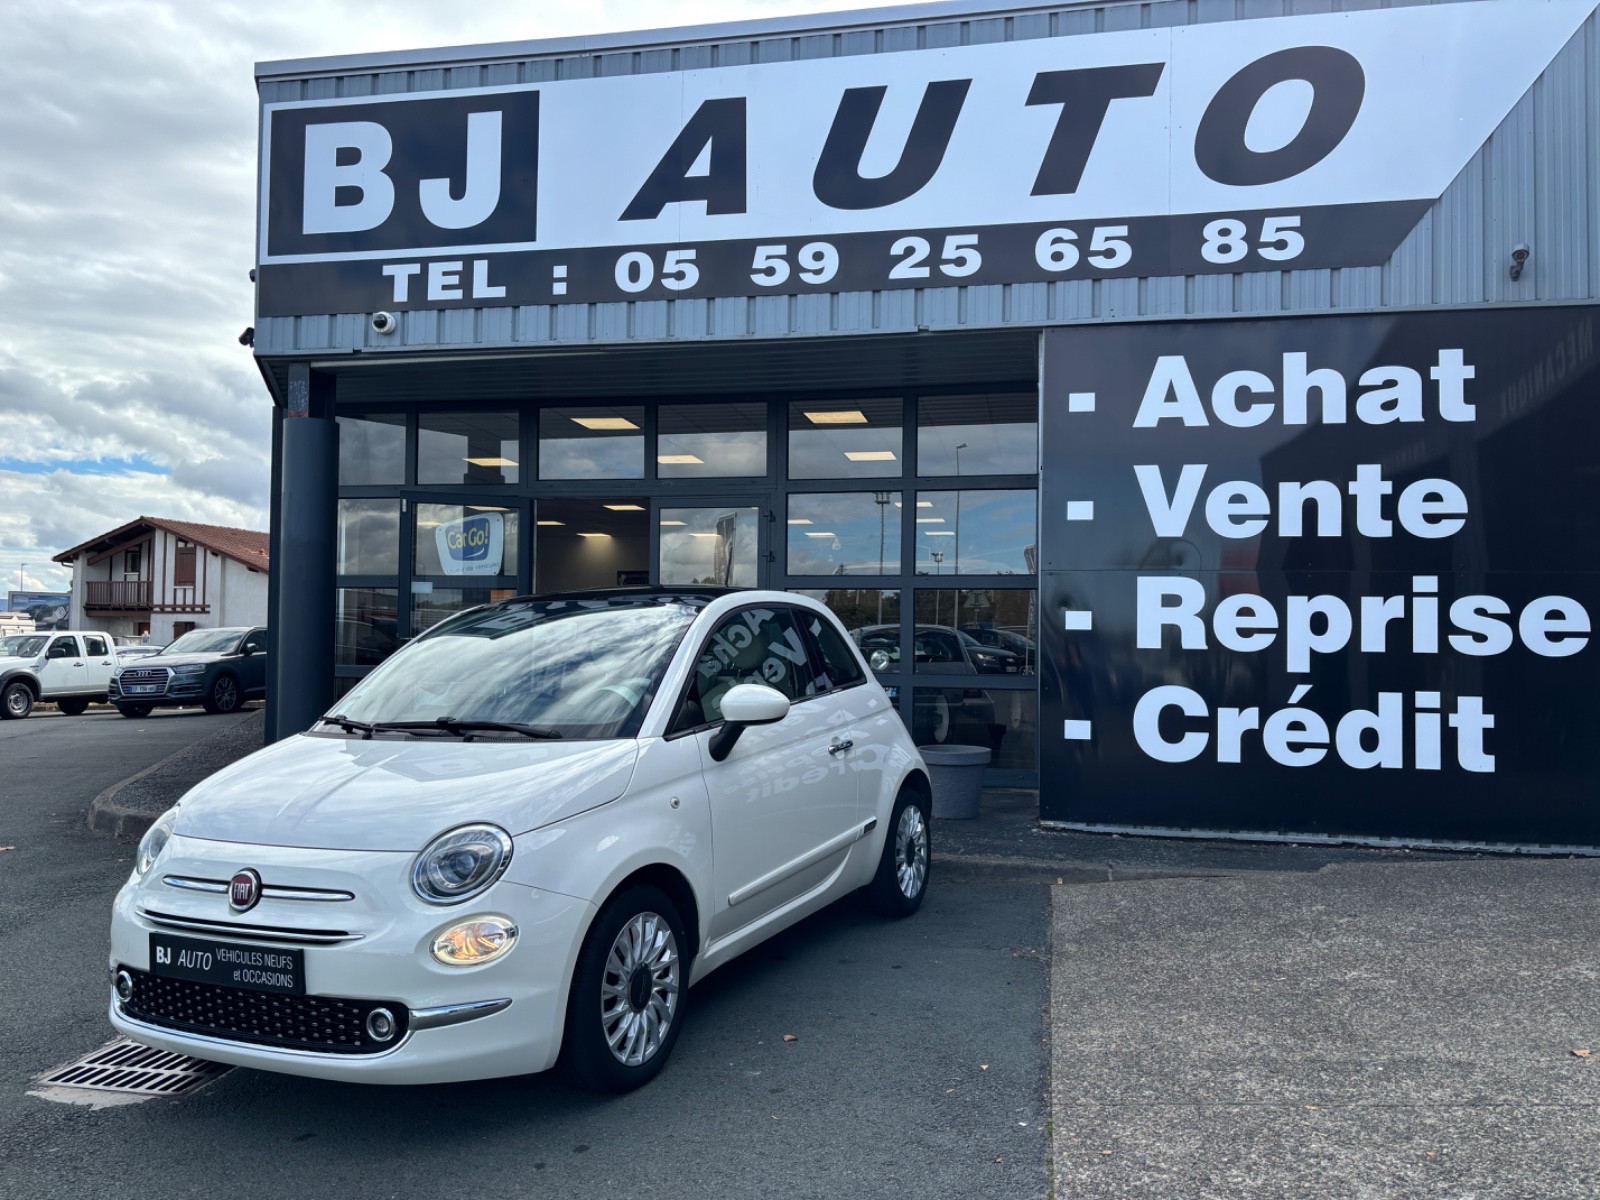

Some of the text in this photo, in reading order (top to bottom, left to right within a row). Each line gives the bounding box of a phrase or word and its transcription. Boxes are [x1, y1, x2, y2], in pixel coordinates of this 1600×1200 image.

[303, 46, 1364, 235] BJ AUTO
[382, 260, 507, 303] TEL
[614, 248, 700, 293] 05
[749, 241, 840, 287] 59
[888, 233, 983, 280] 25
[1034, 224, 1133, 272] 65
[1200, 215, 1305, 264] 85
[1133, 348, 1476, 428] Achat
[1133, 463, 1469, 539] Vente
[1136, 575, 1592, 673] Reprise
[1133, 684, 1496, 773] Crédit
[233, 883, 250, 900] FIAT
[156, 946, 212, 970] BJ AUTO
[215, 947, 293, 970] VEHICULES NEUFS
[233, 969, 294, 988] et OCCASIONS
